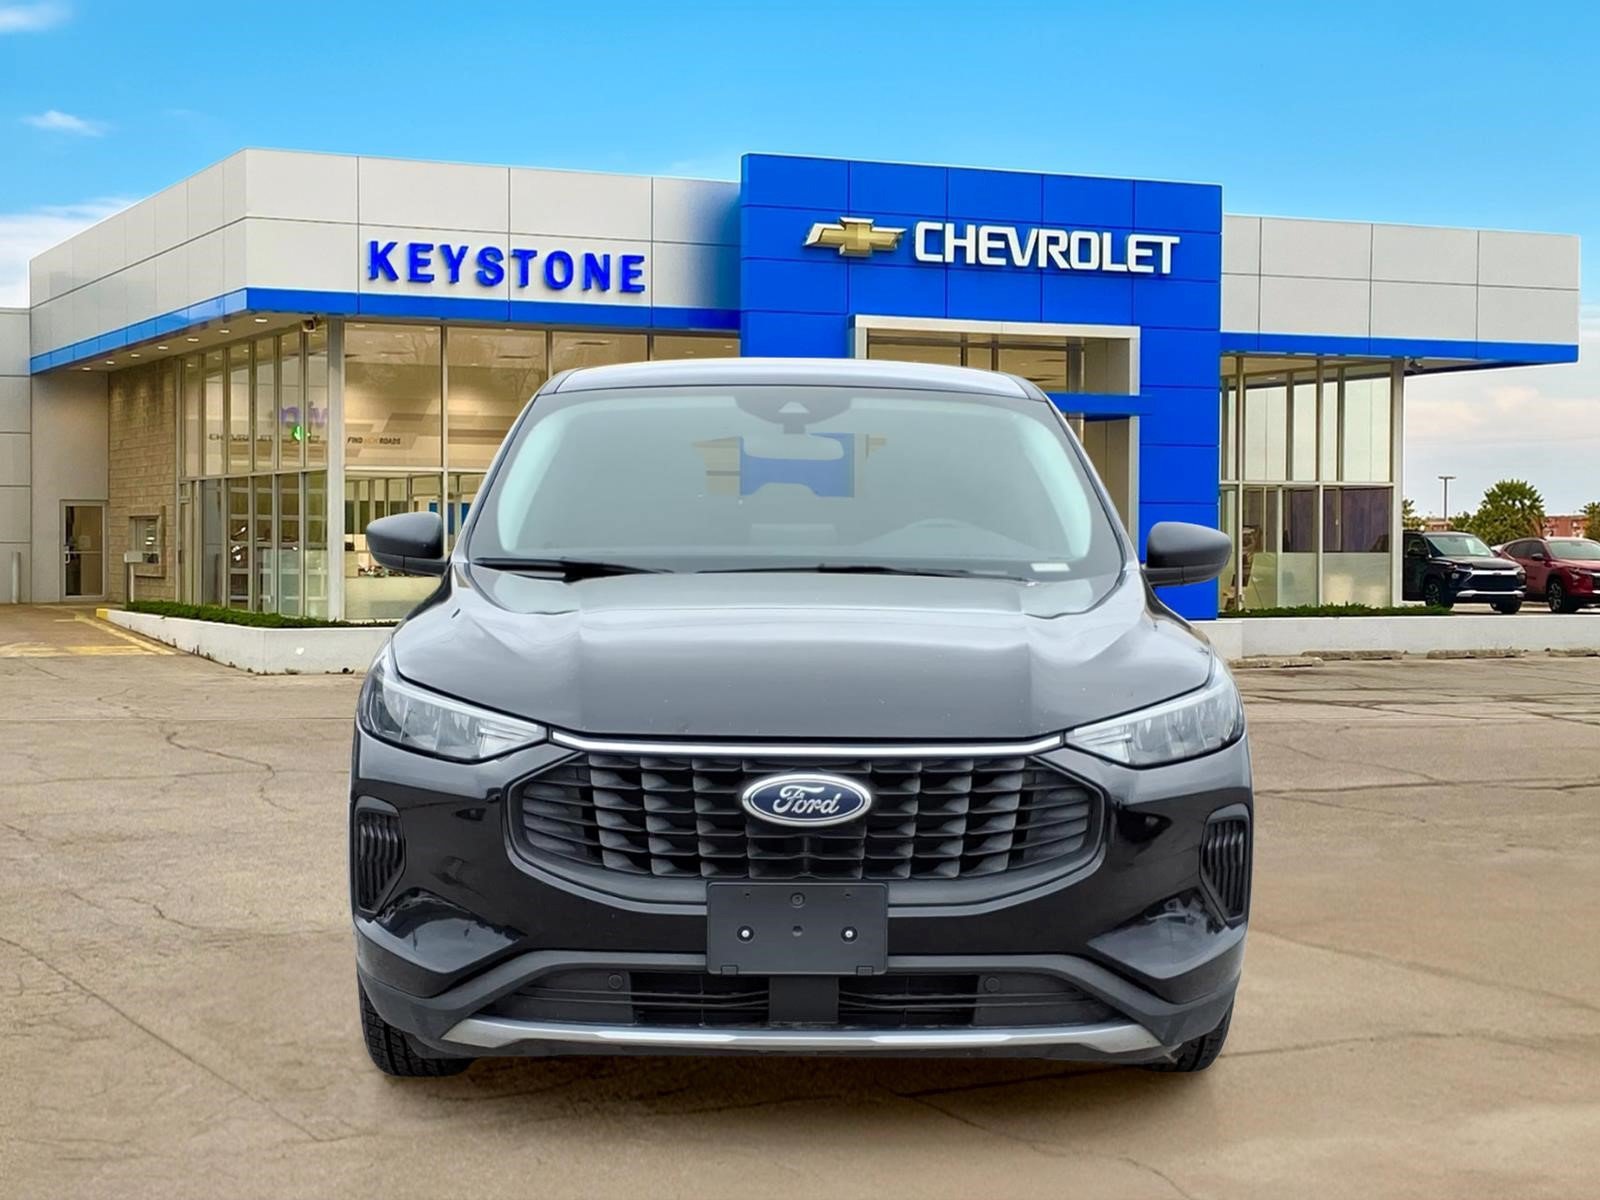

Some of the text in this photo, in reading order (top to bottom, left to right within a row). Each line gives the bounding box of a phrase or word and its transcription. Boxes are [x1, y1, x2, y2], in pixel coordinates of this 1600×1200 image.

[368, 240, 646, 293] KEYSTONE
[914, 221, 1181, 275] CHEVROLET
[773, 785, 842, 813] Ford
